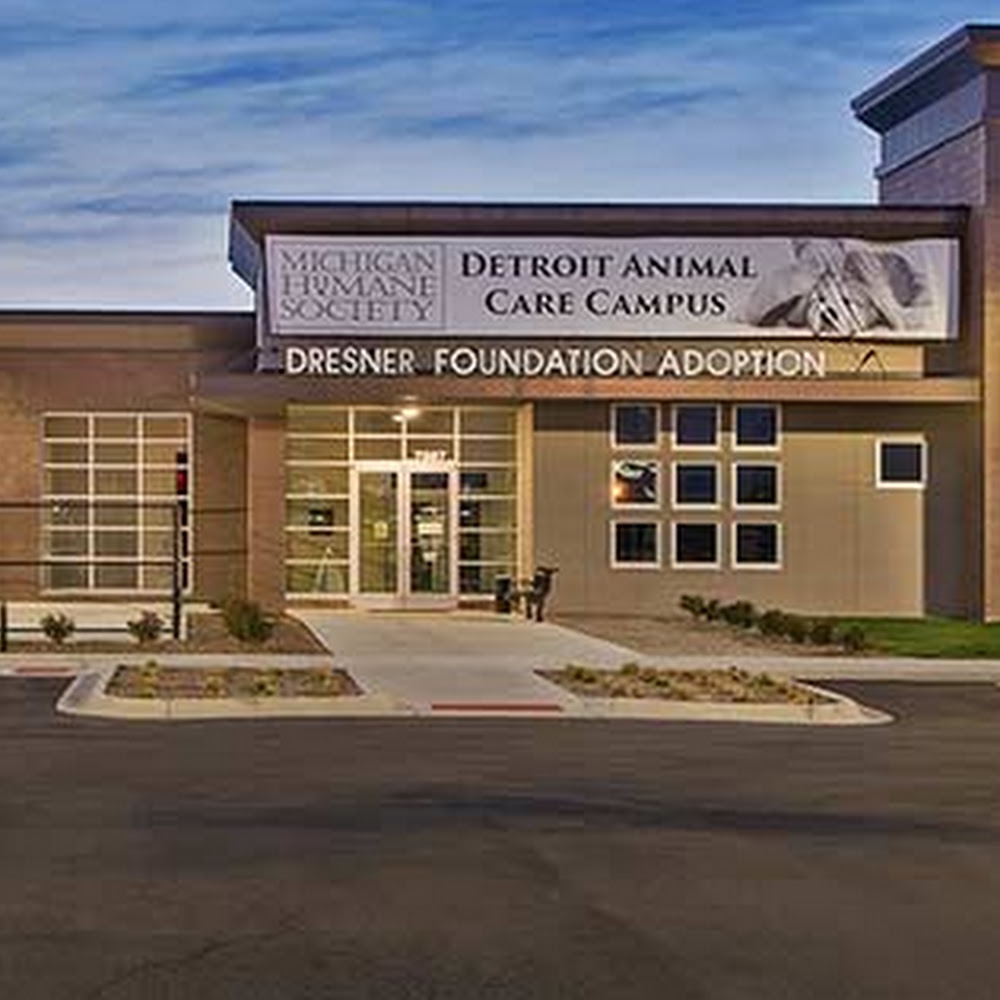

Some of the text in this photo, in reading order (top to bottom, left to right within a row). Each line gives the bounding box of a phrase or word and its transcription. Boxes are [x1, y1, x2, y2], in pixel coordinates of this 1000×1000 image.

[281, 251, 434, 272] MICHIGAN
[461, 252, 757, 278] DETROIT ANIMAL
[281, 298, 434, 321] SOCIETY
[485, 288, 727, 316] CARE CAMPUS
[286, 347, 826, 377] DRESNER FOUNDATION ADOPTION
